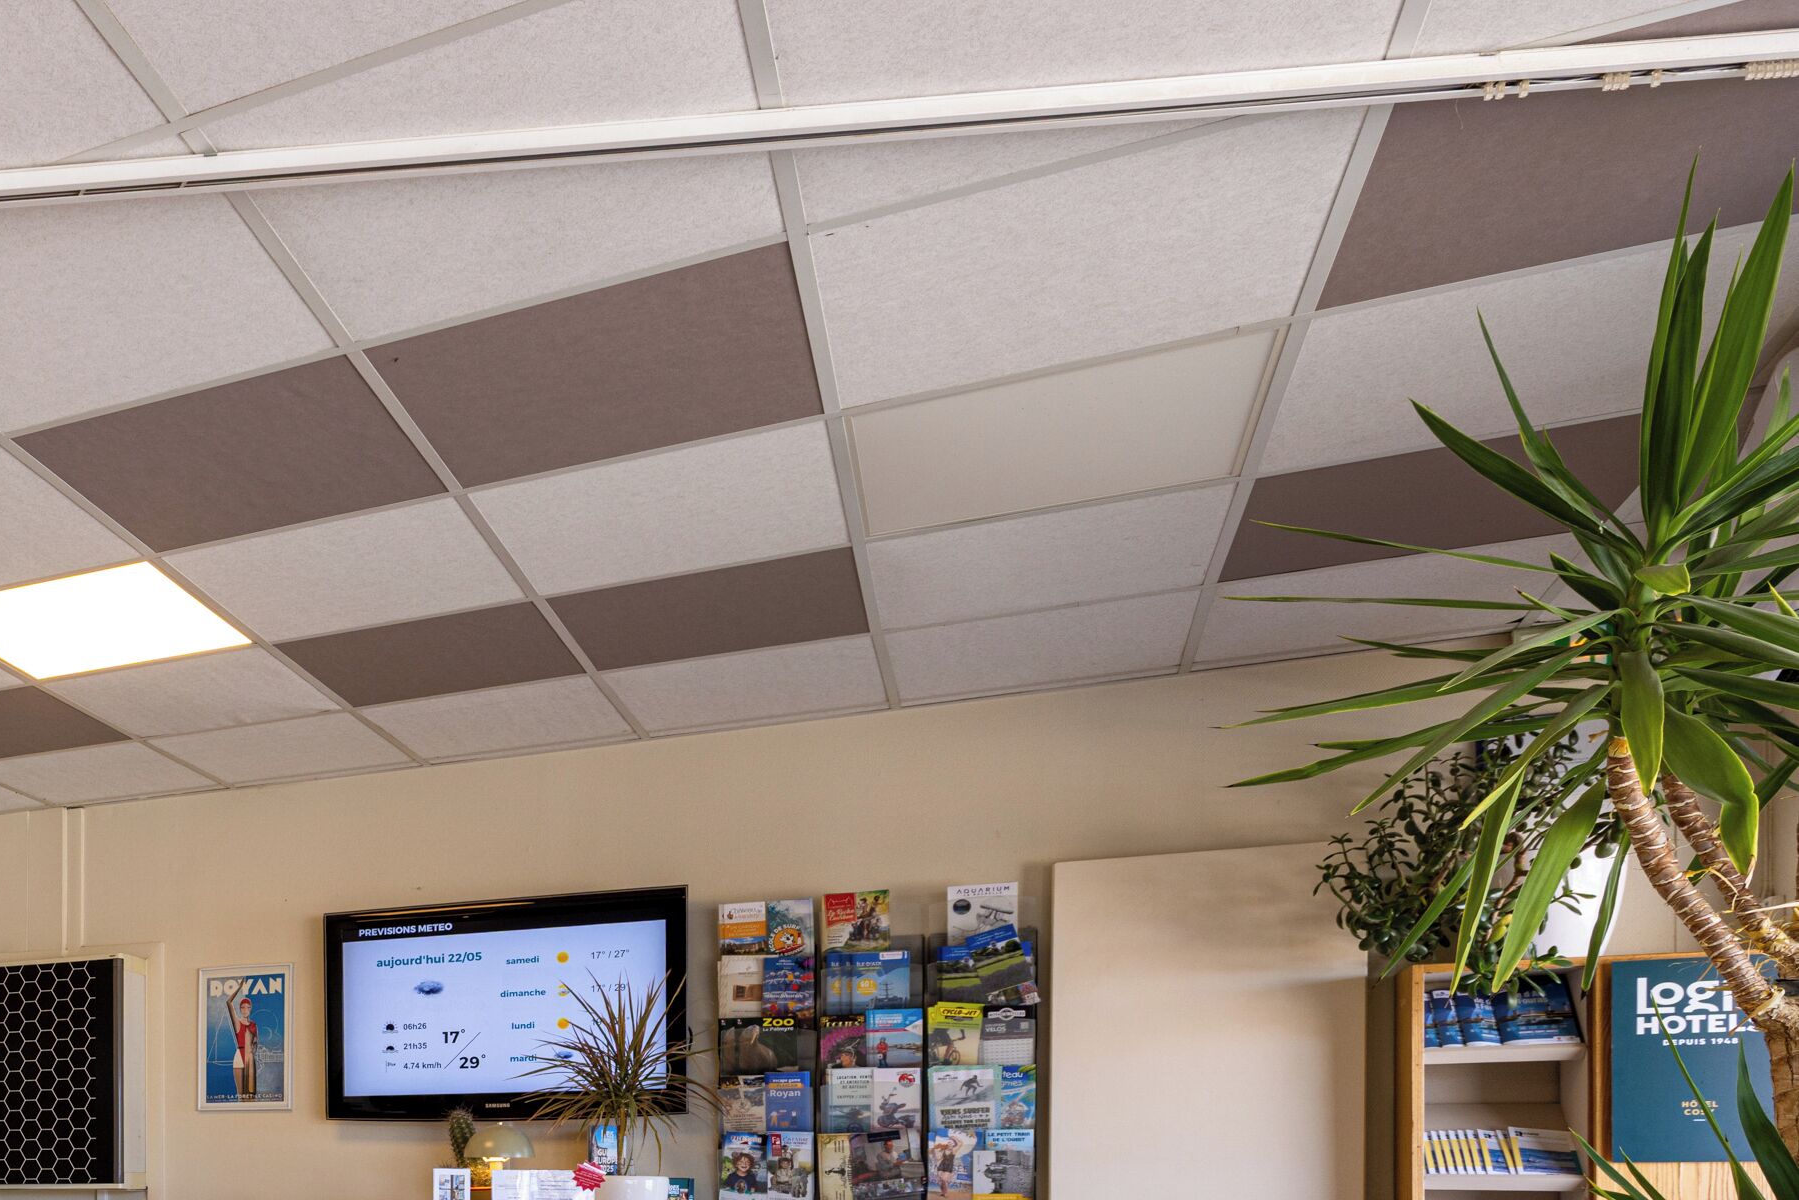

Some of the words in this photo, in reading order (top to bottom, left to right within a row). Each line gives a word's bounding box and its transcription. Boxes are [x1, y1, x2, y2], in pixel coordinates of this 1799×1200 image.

[956, 885, 1010, 895] AQUARIUM
[358, 925, 417, 937] PREVISIONS
[418, 922, 453, 933] METEO
[376, 953, 445, 969] aujourd'hui
[448, 952, 482, 963] 22/05
[505, 955, 540, 965] samedi
[209, 976, 283, 998] ROYAN
[500, 988, 547, 998] dimanche
[403, 1022, 427, 1031] 06h26
[511, 1021, 535, 1030] lundi
[403, 1042, 427, 1050] 21h35
[1662, 1038, 1706, 1046] DEPUIS
[1711, 1037, 1739, 1045] 1948
[509, 1053, 538, 1063] mardi
[403, 1061, 420, 1070] 4.74
[422, 1061, 442, 1069] km/h
[1002, 1071, 1024, 1079] teau
[769, 1089, 801, 1099] Royan
[1681, 1099, 1718, 1108] HÔEL
